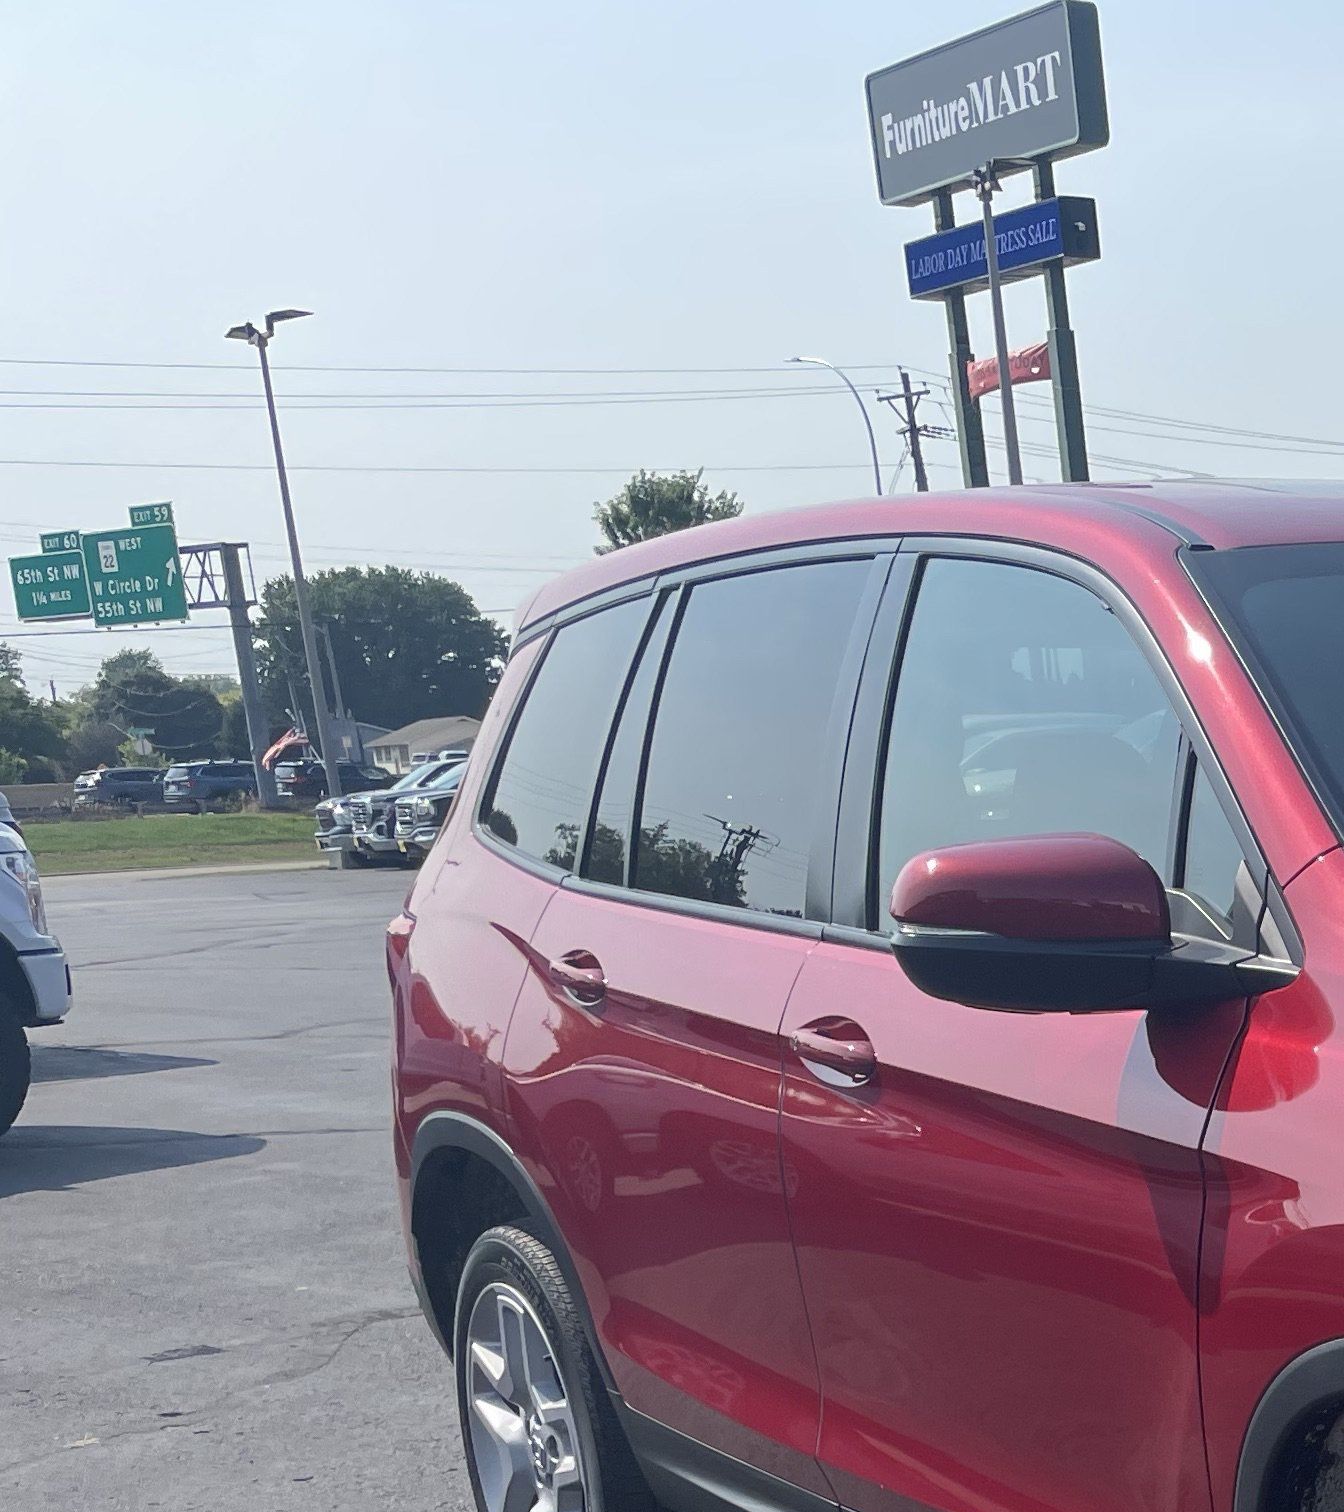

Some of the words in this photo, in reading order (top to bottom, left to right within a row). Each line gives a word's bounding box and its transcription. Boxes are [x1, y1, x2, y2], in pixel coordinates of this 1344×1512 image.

[881, 51, 1061, 158] FurnitureMART
[911, 254, 945, 280] LABOR
[947, 244, 970, 274] DAY
[970, 226, 1027, 266] MATRESS
[1028, 219, 1057, 247] SALE
[133, 510, 151, 523] EXIT
[154, 507, 168, 522] 59
[44, 537, 60, 549] EXIT
[63, 534, 78, 549] 60
[118, 537, 142, 551] WEST
[103, 554, 116, 569] 22
[17, 568, 44, 585] 65th
[47, 566, 60, 582] St
[64, 564, 80, 580] NW
[93, 580, 103, 597] W
[108, 577, 141, 595] Circle
[146, 575, 159, 592] Dr
[50, 590, 72, 602] MILES
[97, 601, 125, 618] 55th
[129, 599, 142, 615] St
[146, 597, 164, 614] NW
